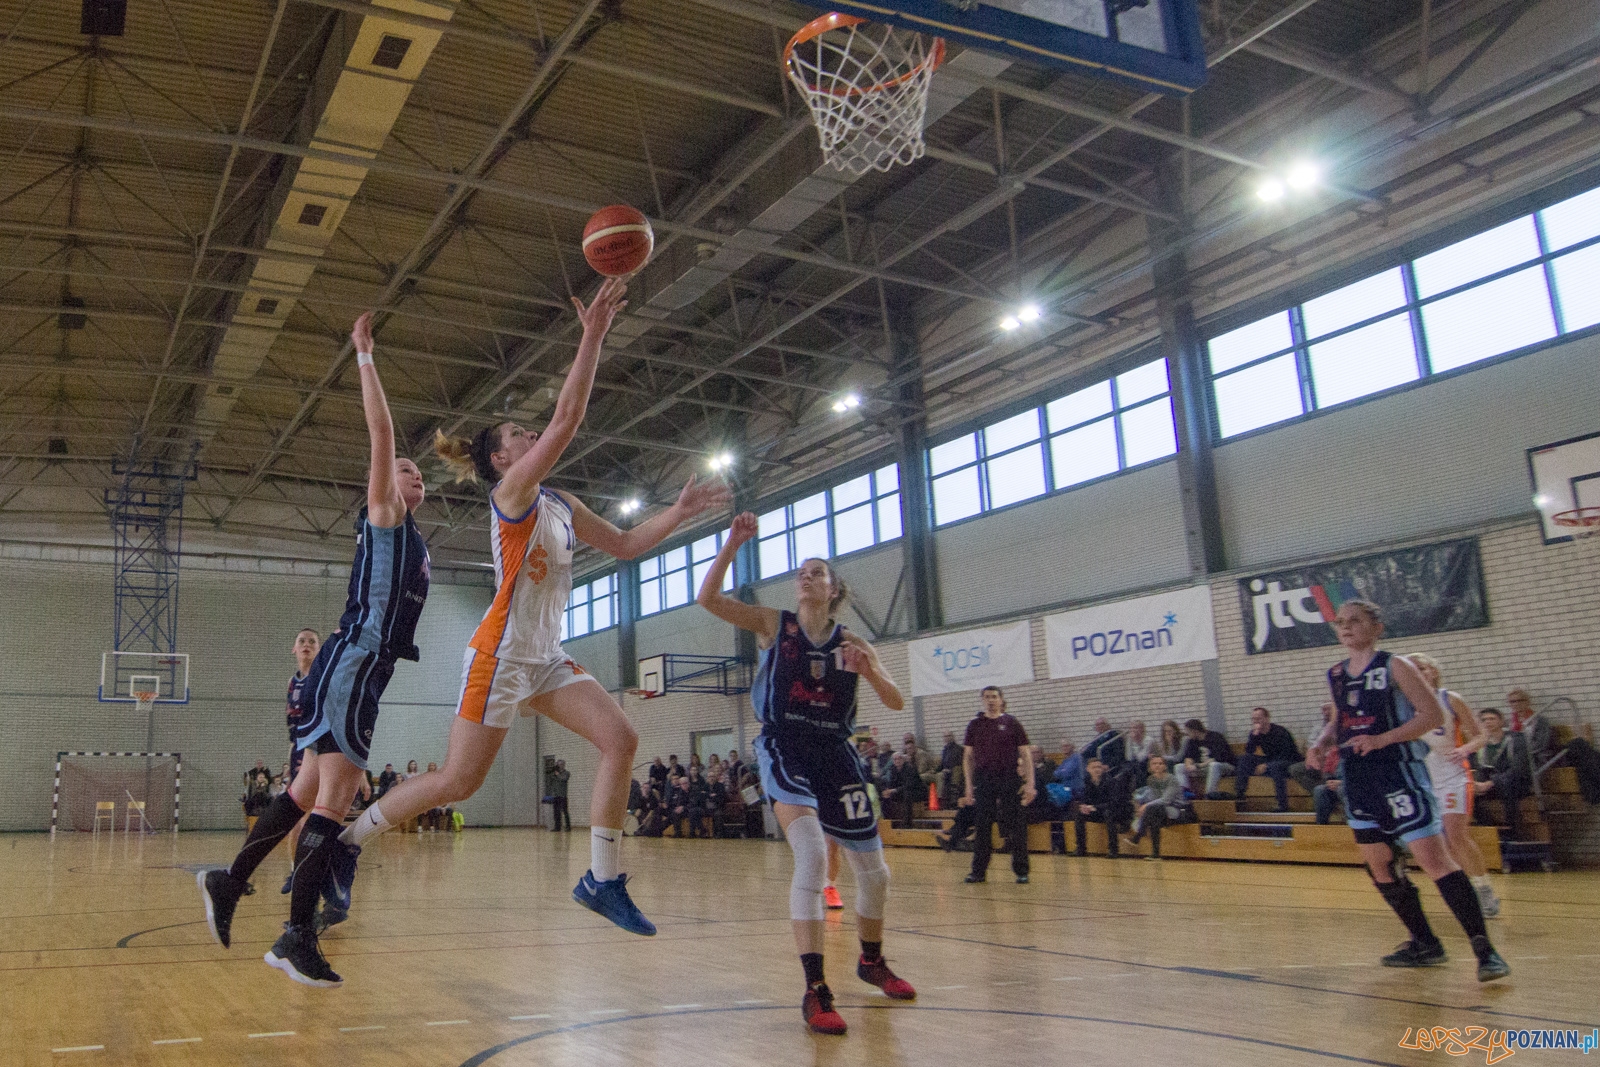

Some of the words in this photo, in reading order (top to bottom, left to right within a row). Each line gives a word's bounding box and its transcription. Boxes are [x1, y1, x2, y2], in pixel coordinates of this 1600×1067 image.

[1363, 667, 1388, 690] 13
[839, 790, 871, 820] 12
[1387, 794, 1415, 818] 13
